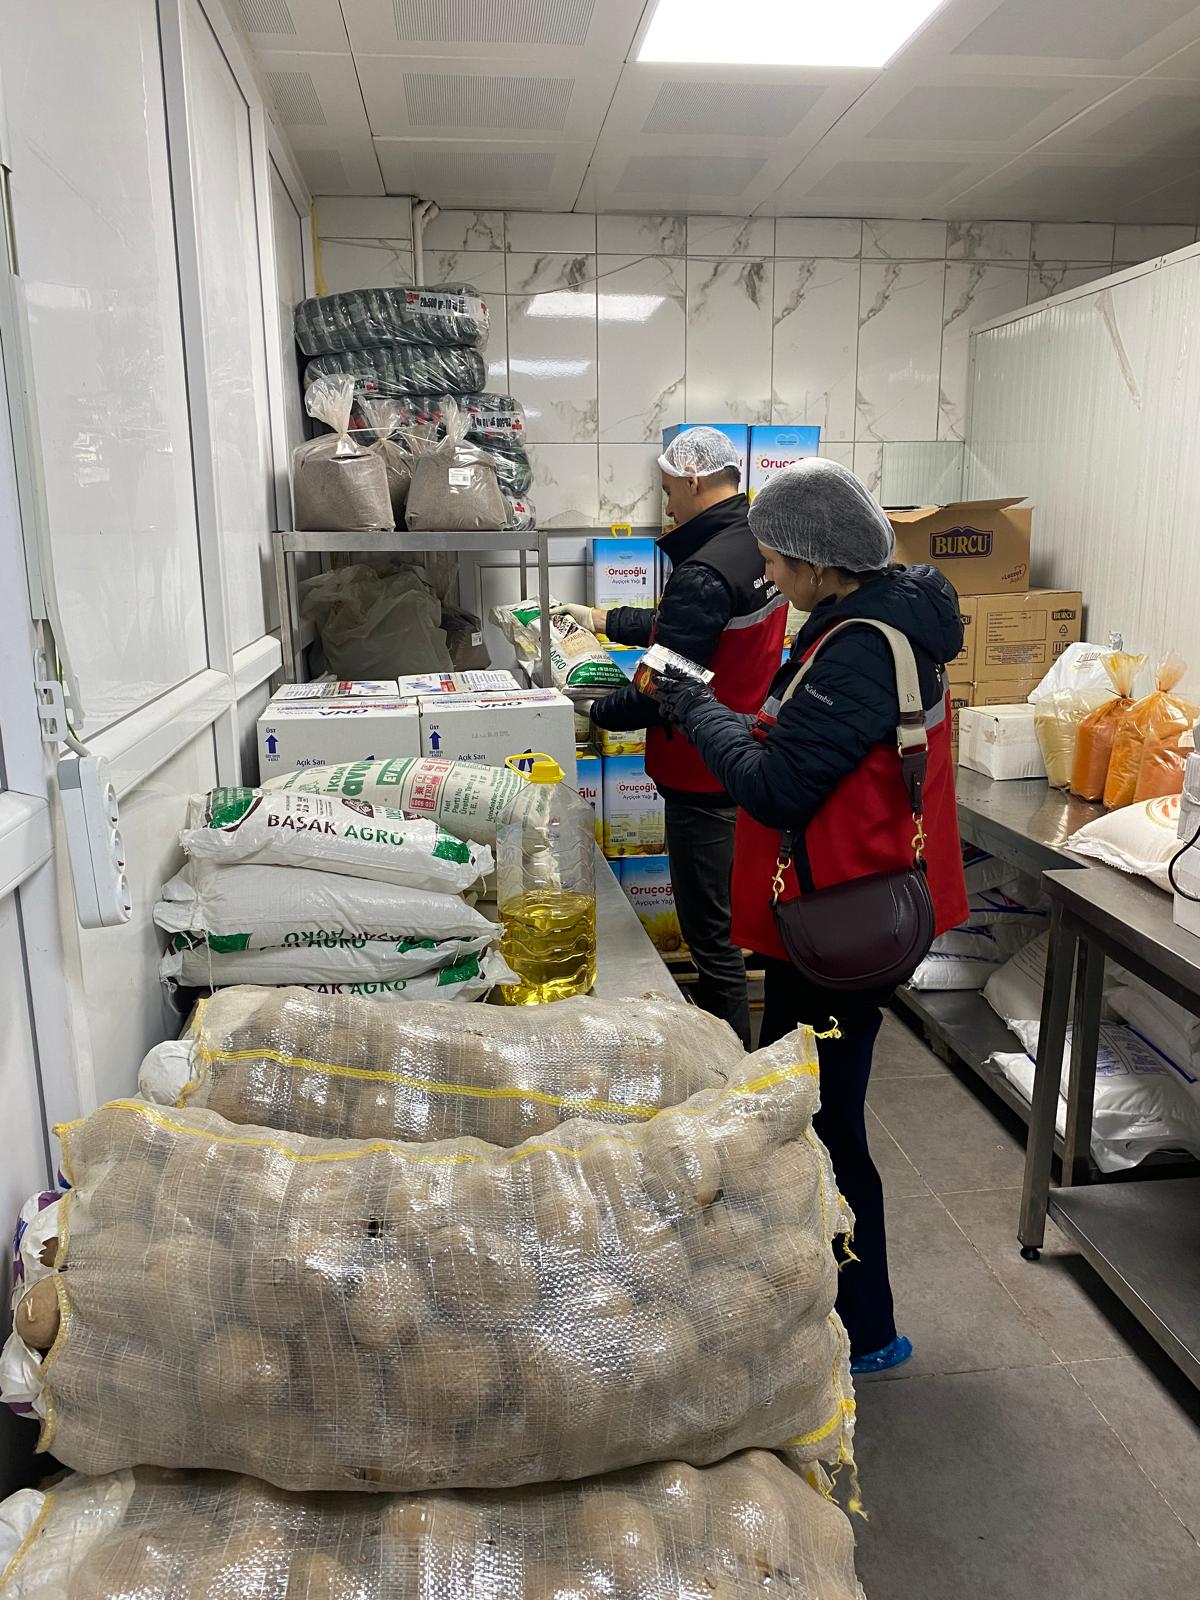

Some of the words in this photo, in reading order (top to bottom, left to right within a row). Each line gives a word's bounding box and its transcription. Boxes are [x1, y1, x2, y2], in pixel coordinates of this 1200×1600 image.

[935, 535, 988, 555] BURCU
[608, 567, 647, 577] Oruçoğlu
[806, 684, 834, 706] Columbia
[296, 759, 312, 767] Açık
[458, 753, 473, 761] Açık
[444, 800, 452, 813] Net
[267, 814, 337, 835] BAŞAK
[344, 825, 404, 845] AGRO
